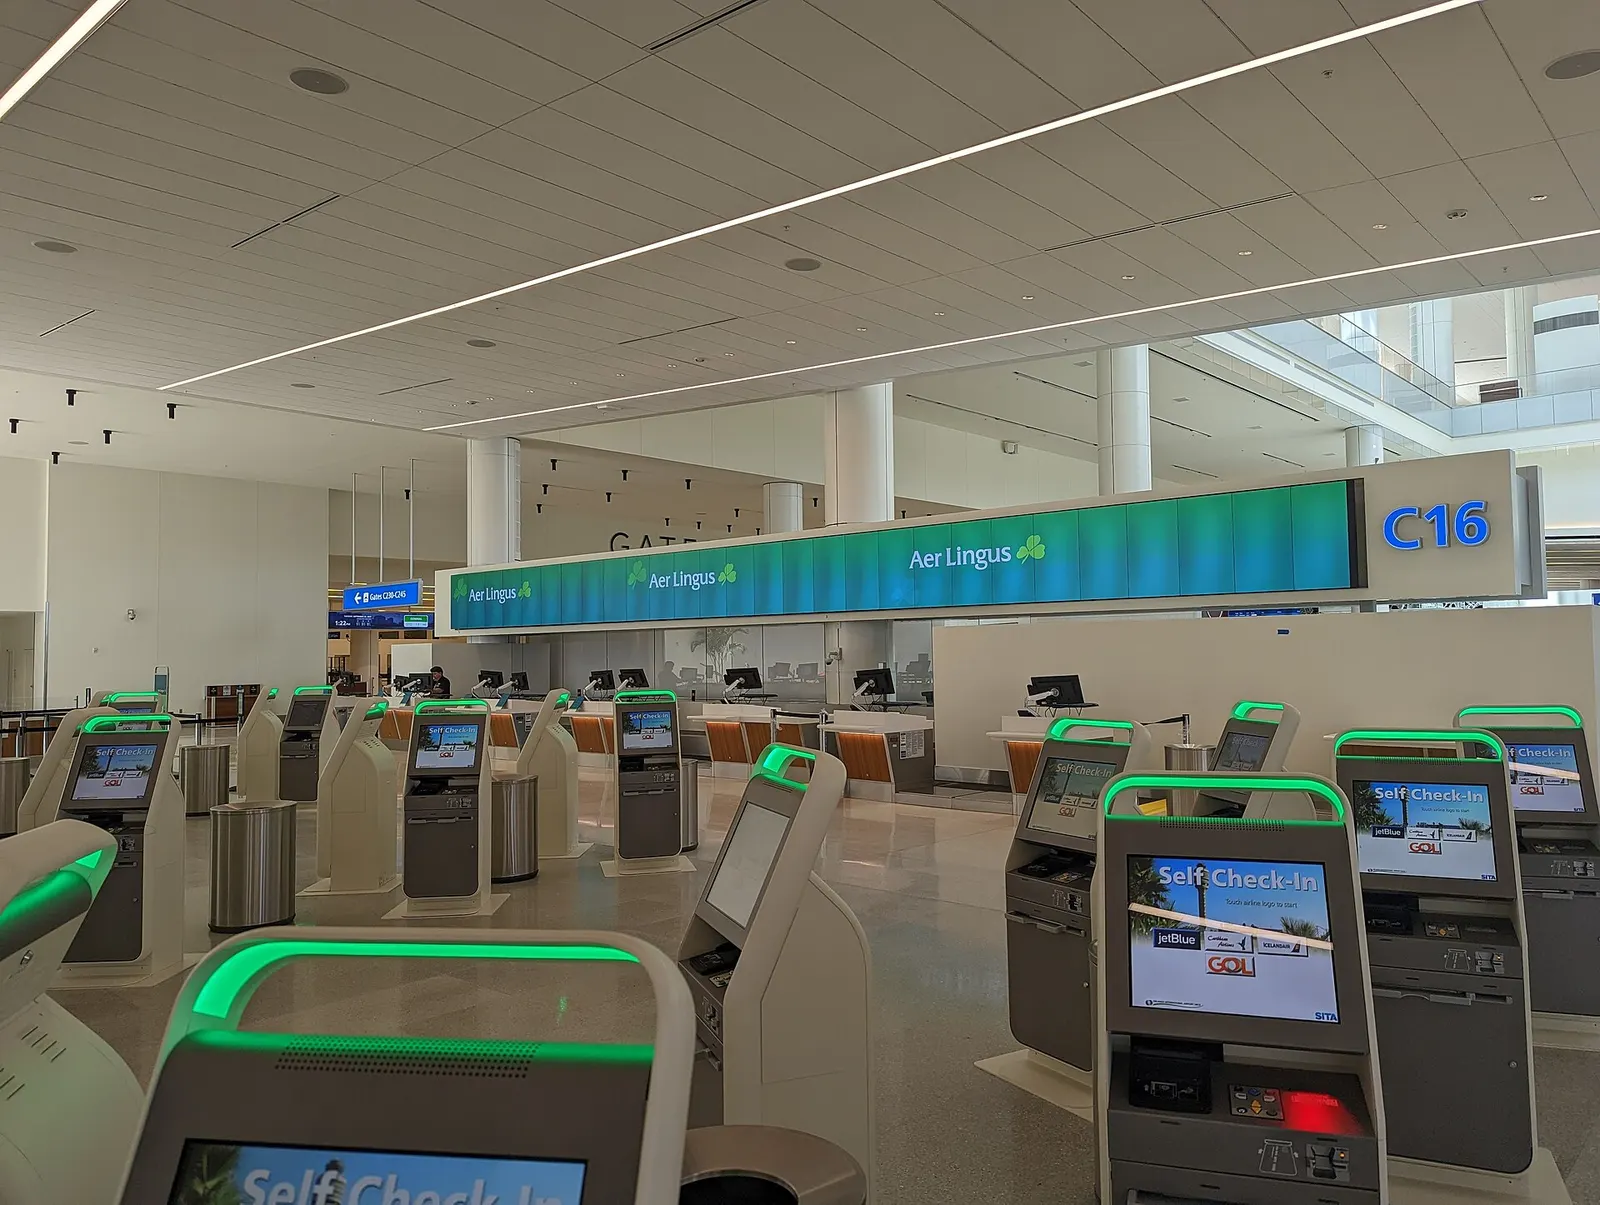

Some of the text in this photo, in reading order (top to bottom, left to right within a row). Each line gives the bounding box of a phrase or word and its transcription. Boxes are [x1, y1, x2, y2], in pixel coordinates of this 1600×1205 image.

[1382, 500, 1488, 550] C16
[909, 546, 1012, 571] Aer Lingus
[649, 570, 716, 590] Aer Lingus
[382, 590, 406, 600] C230-C245
[469, 587, 516, 604] Aer Lingus
[445, 726, 476, 734] Check-In
[96, 747, 154, 757] Self Check-In
[1518, 747, 1571, 758] Check-In
[1055, 763, 1112, 778] Self Check-In
[1374, 787, 1484, 803] Self Check-In
[1375, 828, 1401, 836] jetBlue
[1409, 842, 1440, 854] GOL
[1159, 866, 1319, 892] Self Check-In
[1226, 898, 1242, 906] Touch
[1243, 899, 1260, 907] airline
[1262, 900, 1275, 908] logo
[1157, 932, 1196, 945] jetBlue
[1207, 956, 1253, 974] GOL
[1315, 1011, 1338, 1022] SITA
[240, 1169, 339, 1205] Self
